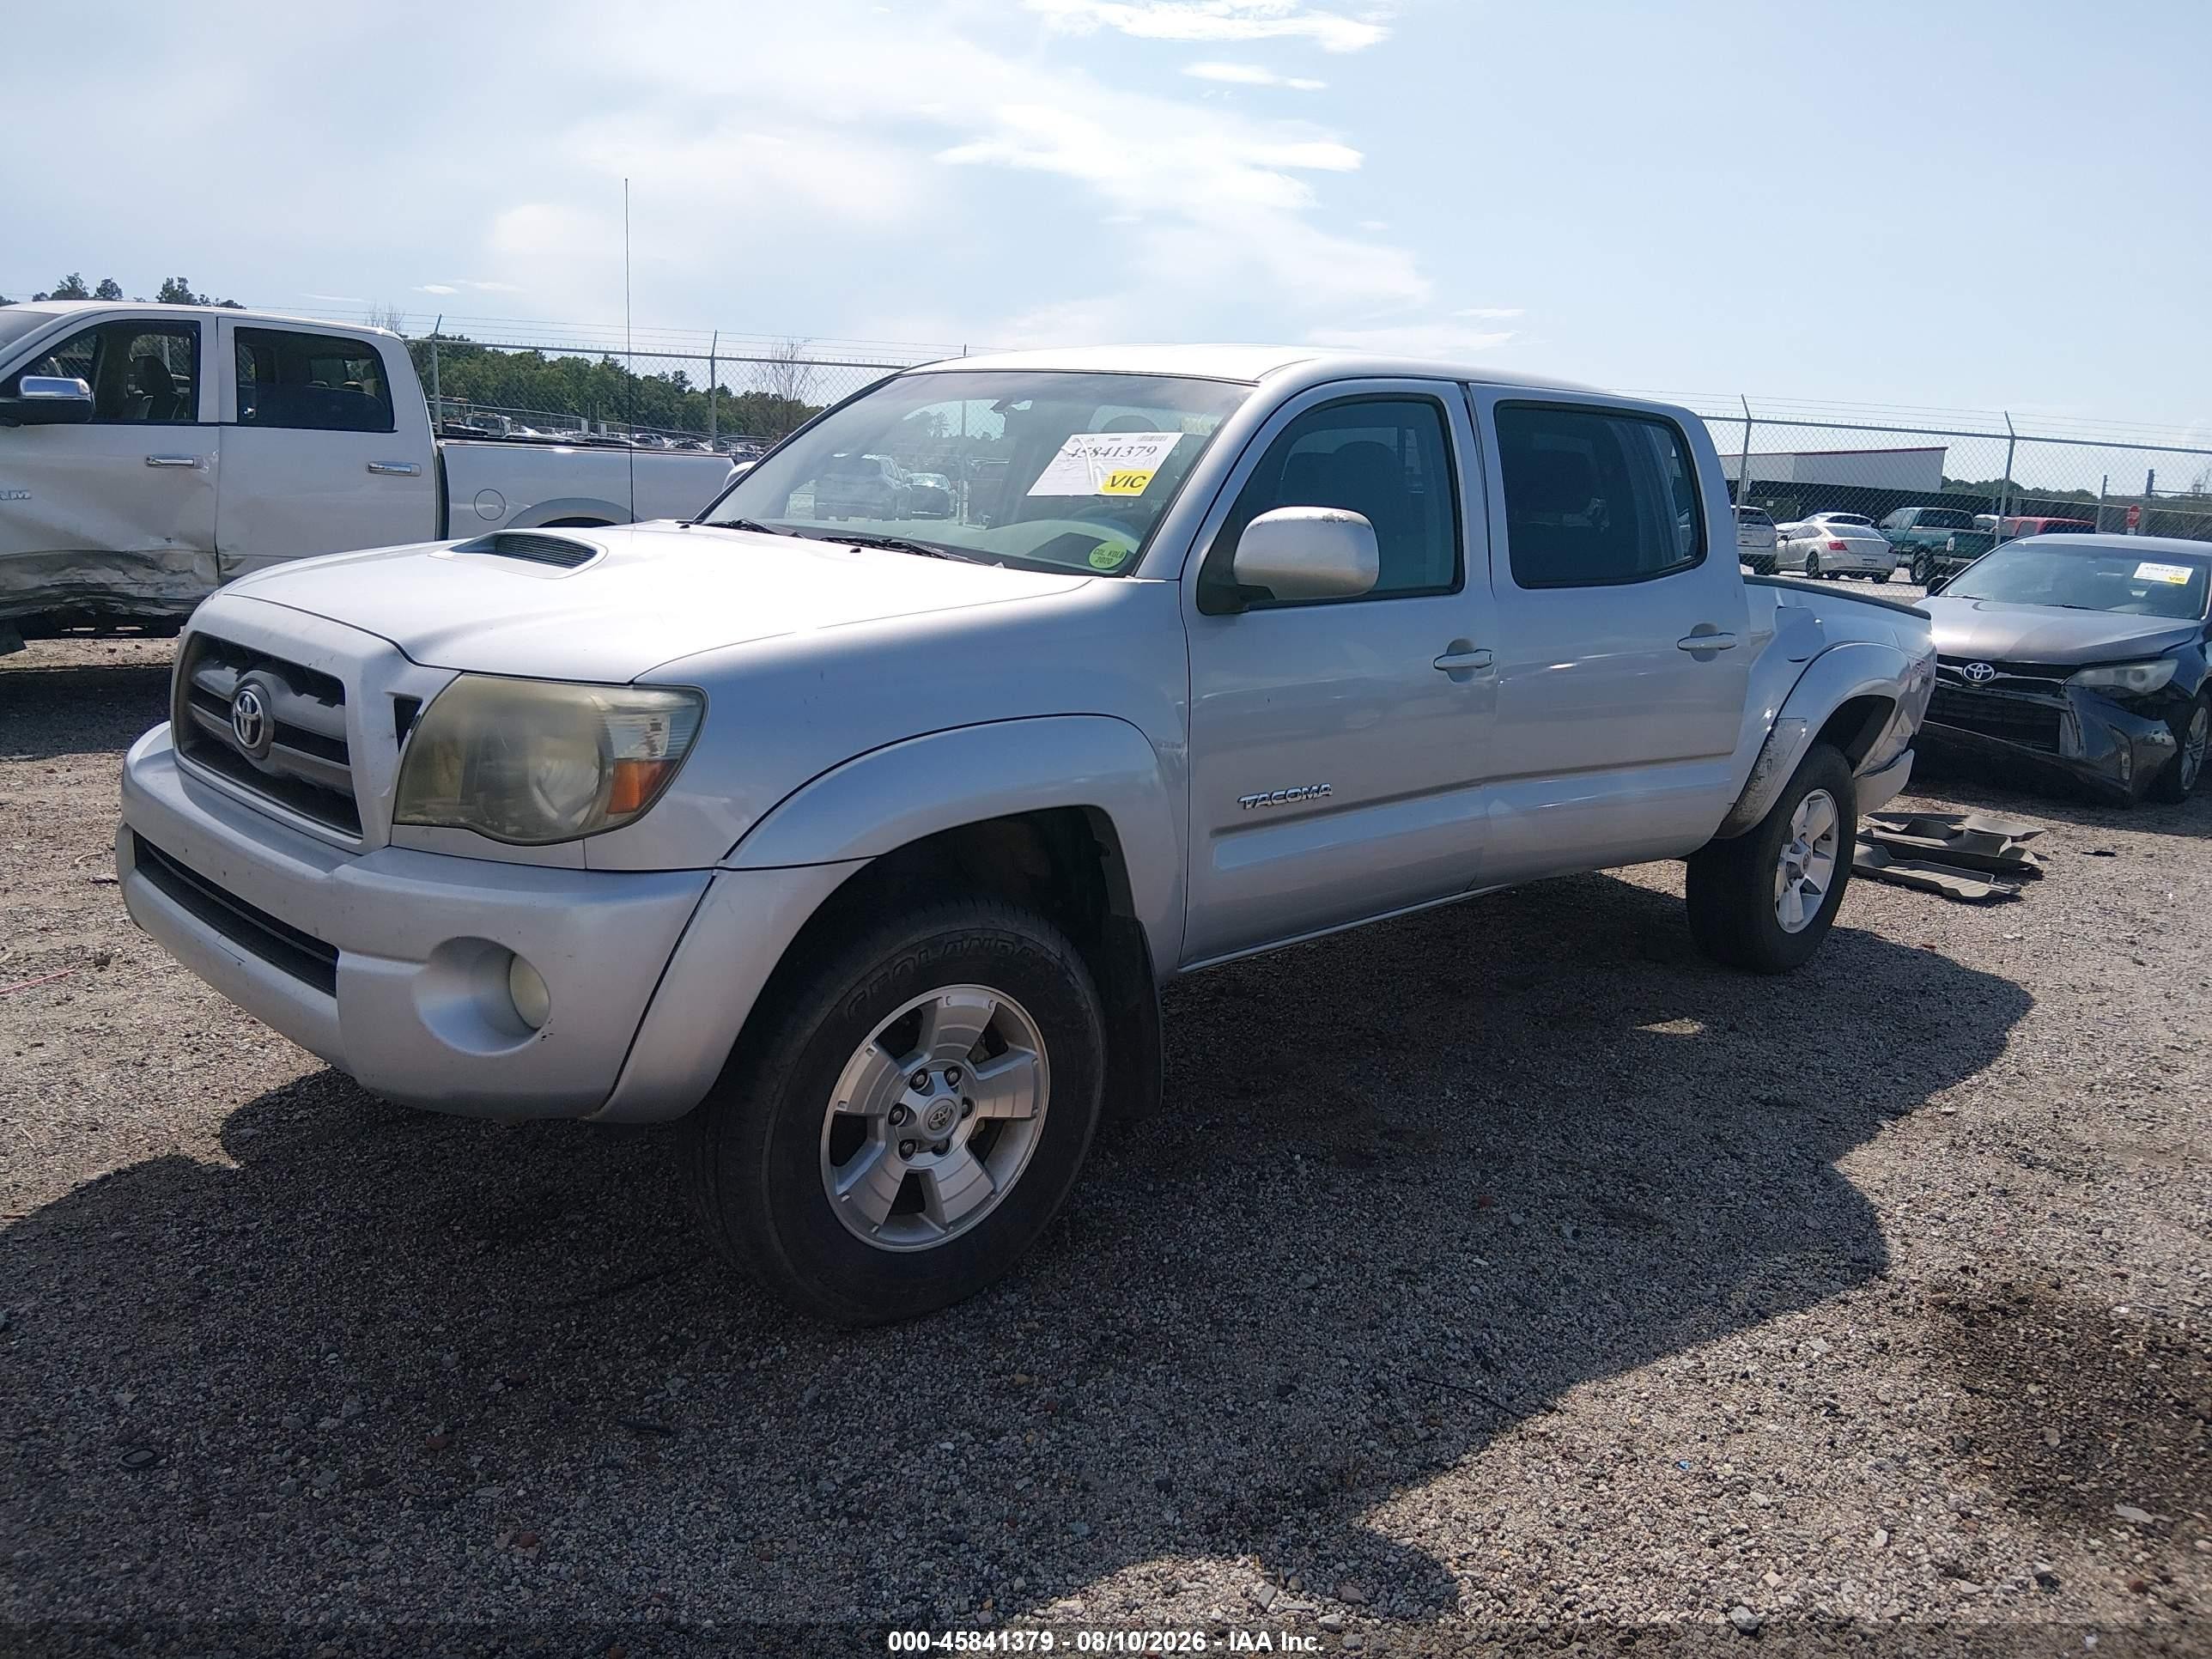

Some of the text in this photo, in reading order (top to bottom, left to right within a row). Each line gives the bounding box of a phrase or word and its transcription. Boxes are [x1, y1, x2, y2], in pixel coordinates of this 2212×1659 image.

[1066, 446, 1158, 459] 45841379
[1109, 475, 1147, 489] VIC
[1237, 782, 1333, 810] TACOMA
